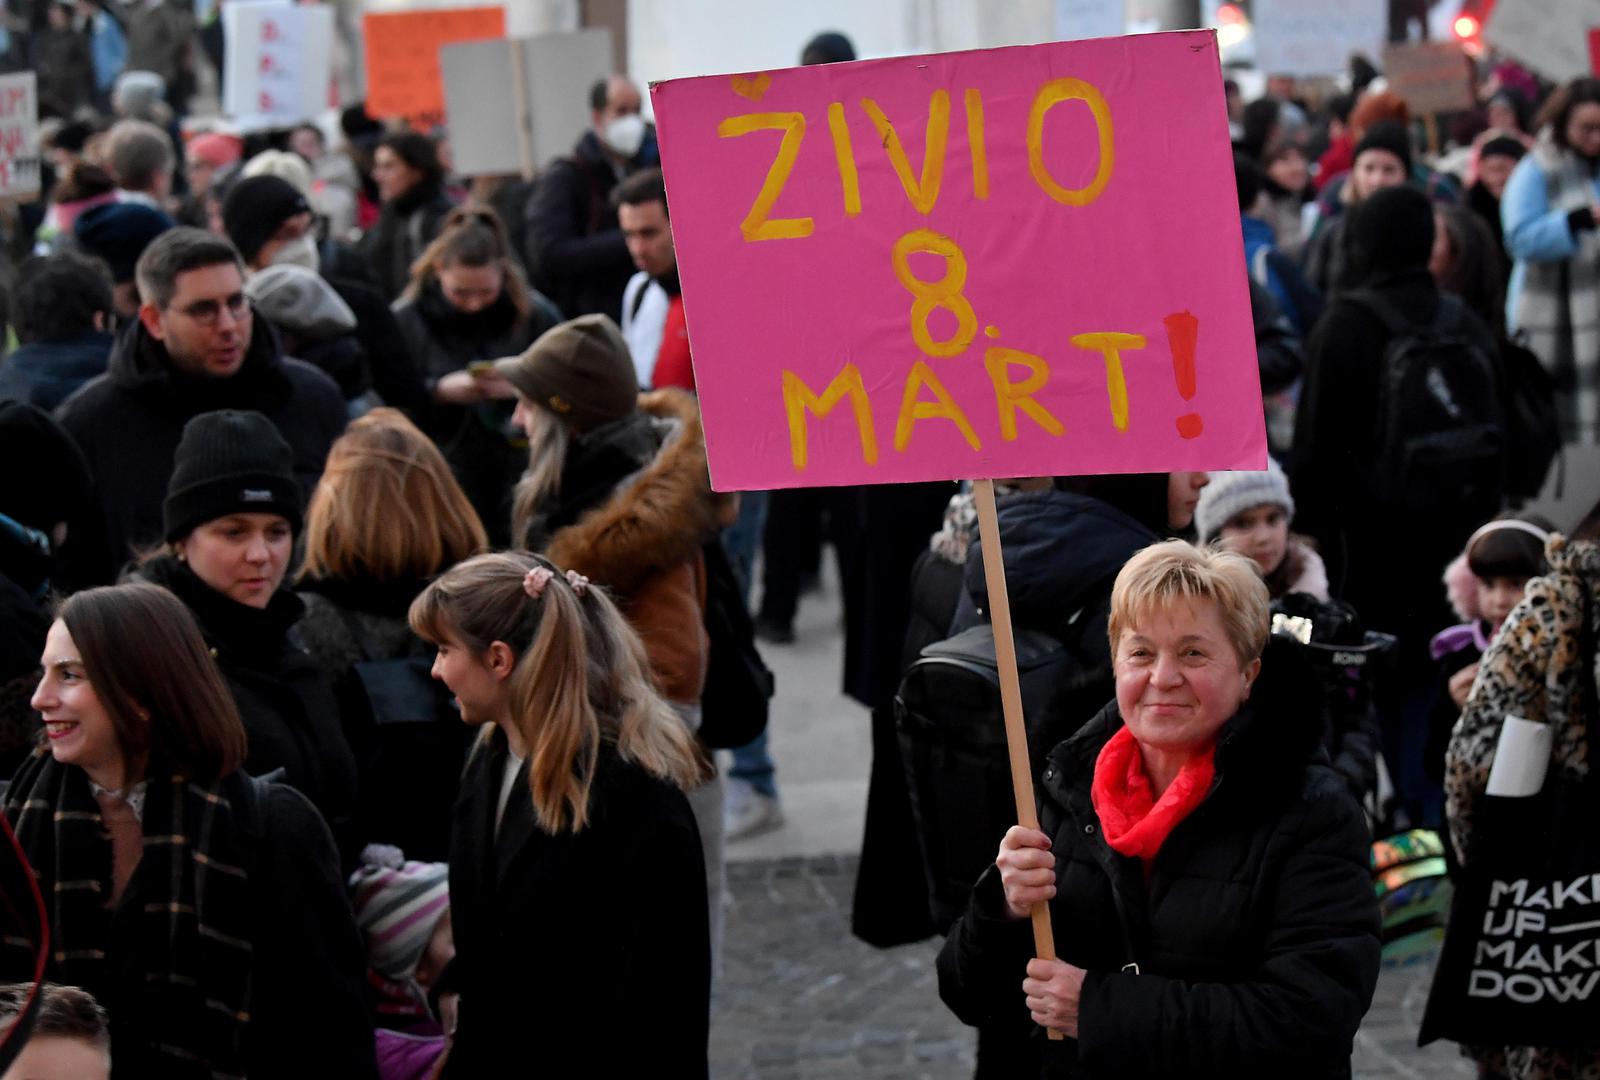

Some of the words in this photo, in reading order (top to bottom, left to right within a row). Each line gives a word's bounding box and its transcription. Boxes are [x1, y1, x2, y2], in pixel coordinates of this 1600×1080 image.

[717, 75, 1115, 243] ŽIVIO
[891, 228, 1000, 358] 8.
[1473, 939, 1600, 973] MAK
